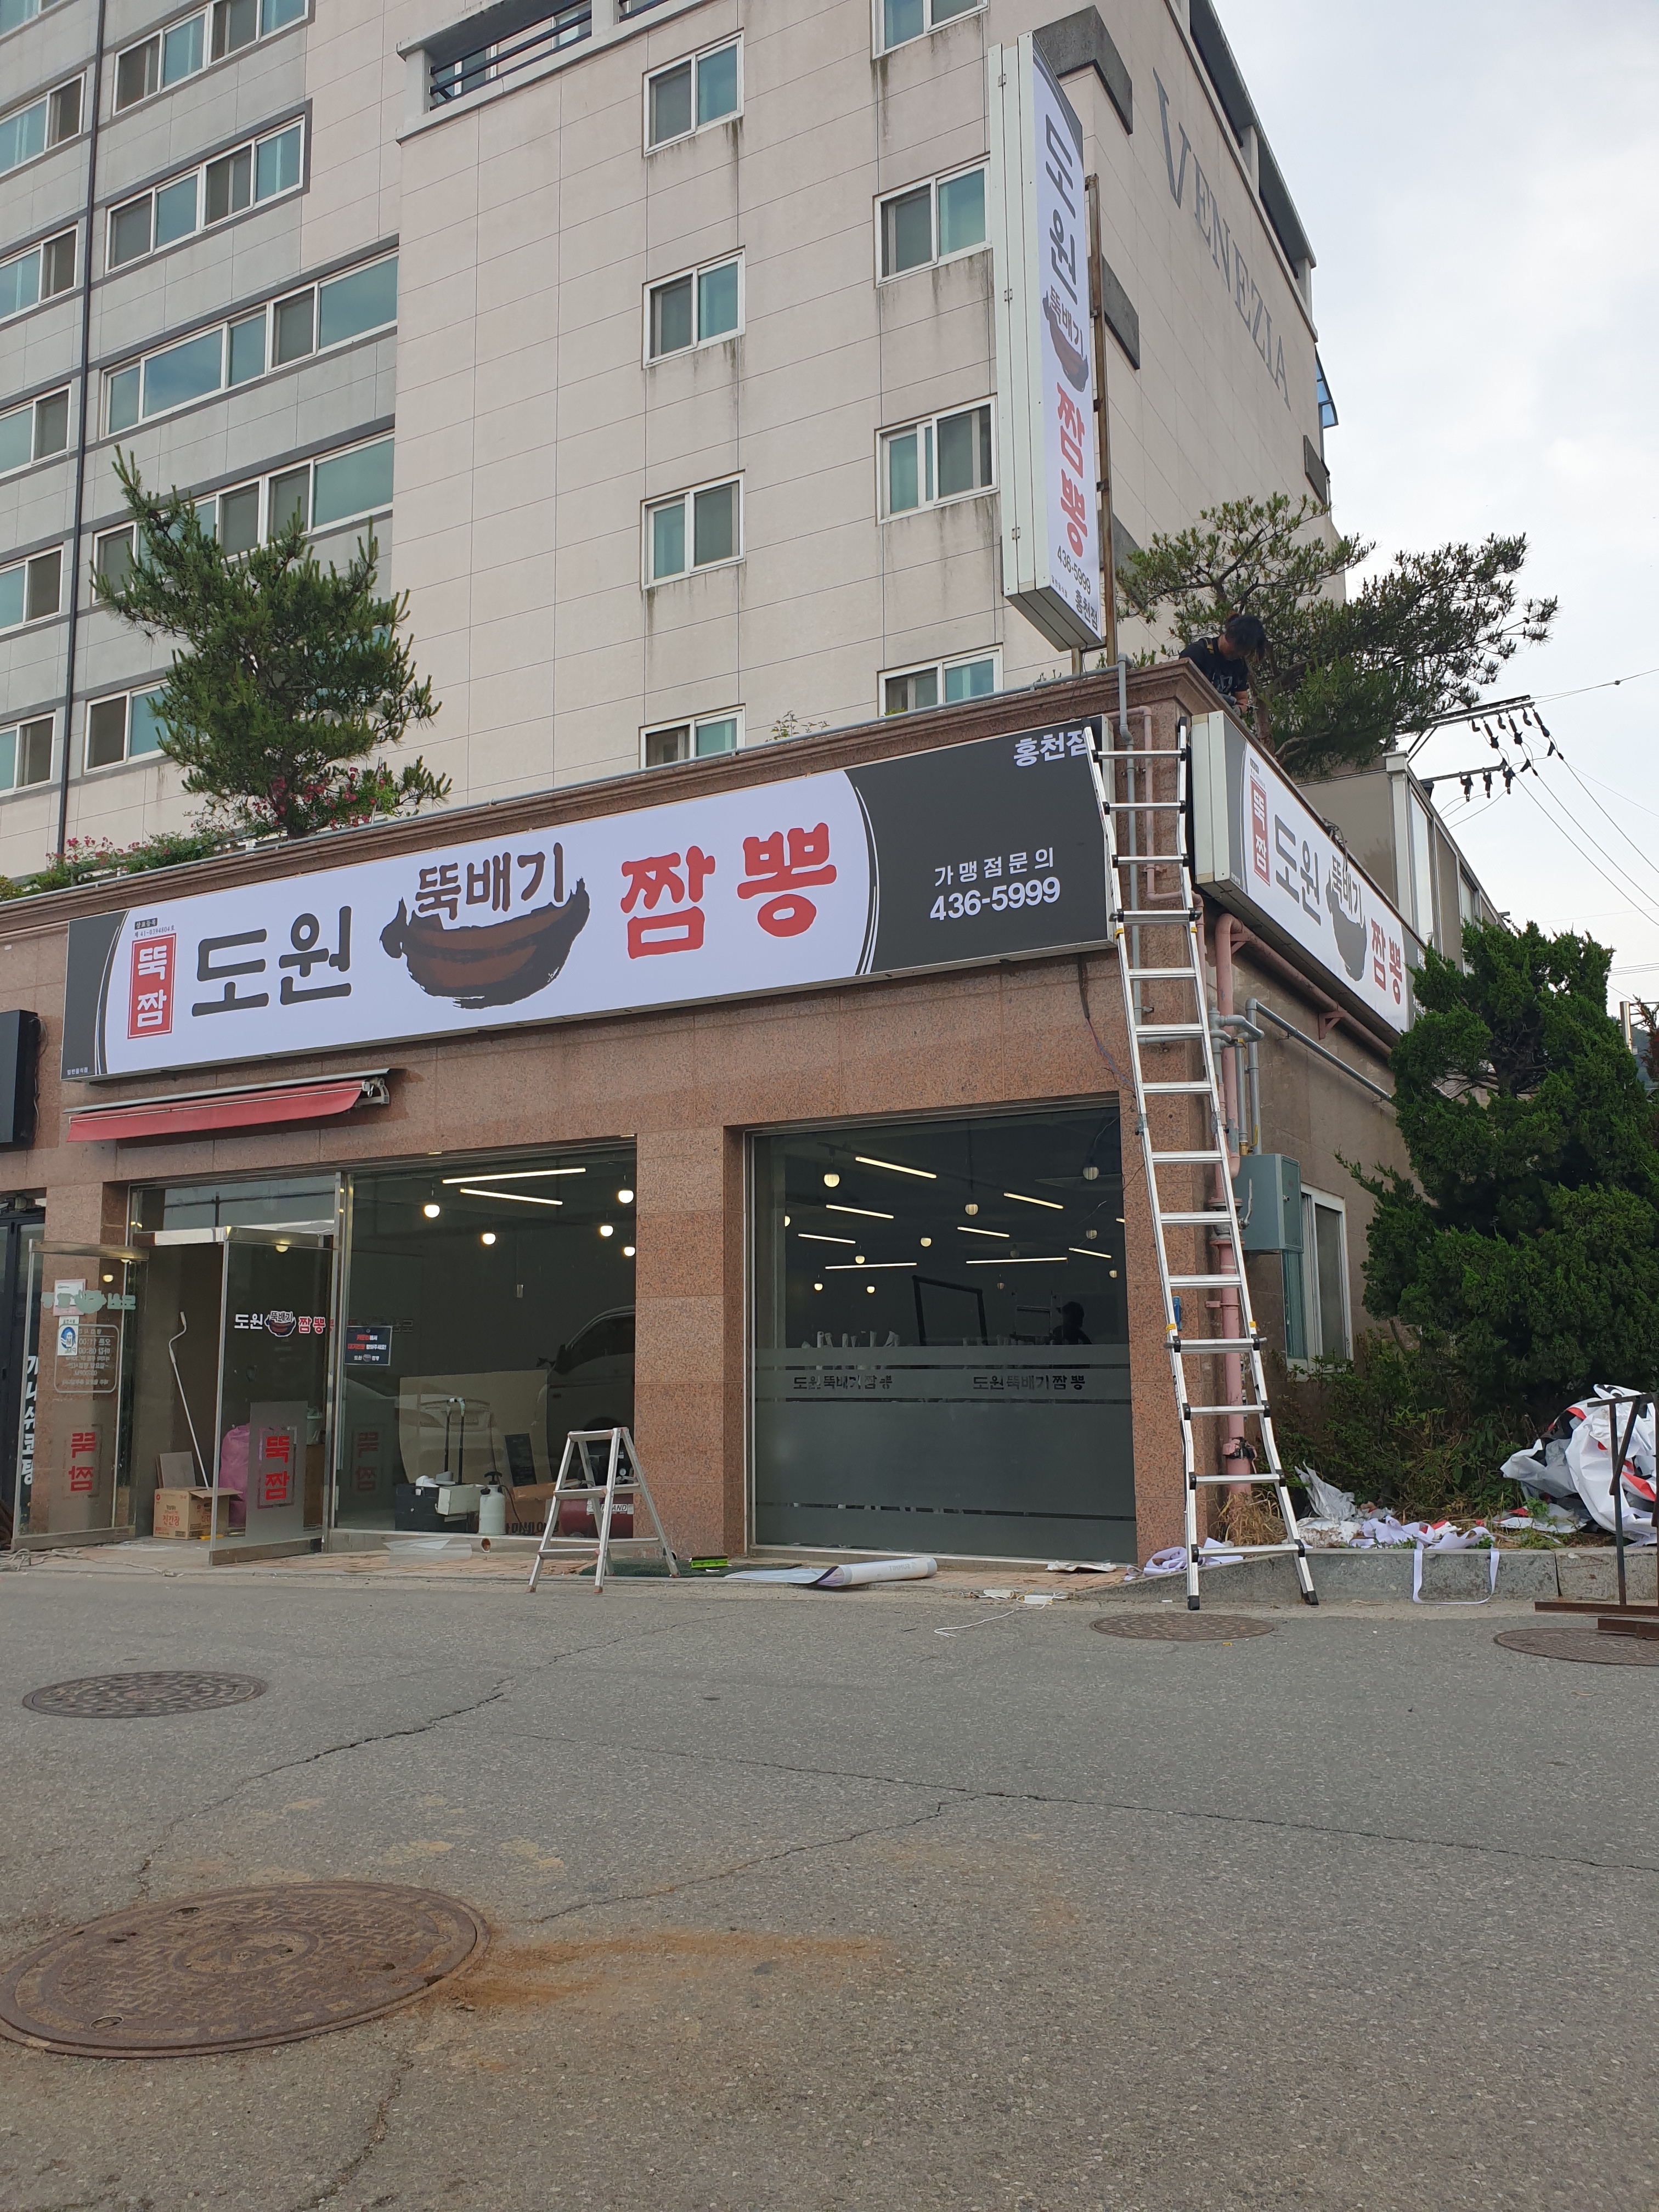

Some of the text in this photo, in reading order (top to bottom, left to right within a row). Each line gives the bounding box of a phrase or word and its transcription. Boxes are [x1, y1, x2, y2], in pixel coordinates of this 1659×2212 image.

[1153, 67, 1291, 411] VENEZIA
[1045, 113, 1088, 558] 도원 뚝배기 짬뽕
[1057, 545, 1091, 595] 436-5999
[1075, 589, 1098, 631] 홍천점
[1013, 730, 1087, 767] 홍천점
[191, 821, 838, 1018] 도원 뚝배기 짬뽕
[929, 876, 1061, 922] 436-5999
[1274, 814, 1403, 1006] 도원 뚝배기 짬뽕
[234, 1313, 263, 1330] 도원
[270, 1311, 294, 1323] 뚝배기
[298, 1316, 326, 1334] 짬뽕
[162, 1515, 180, 1526] 진간장
